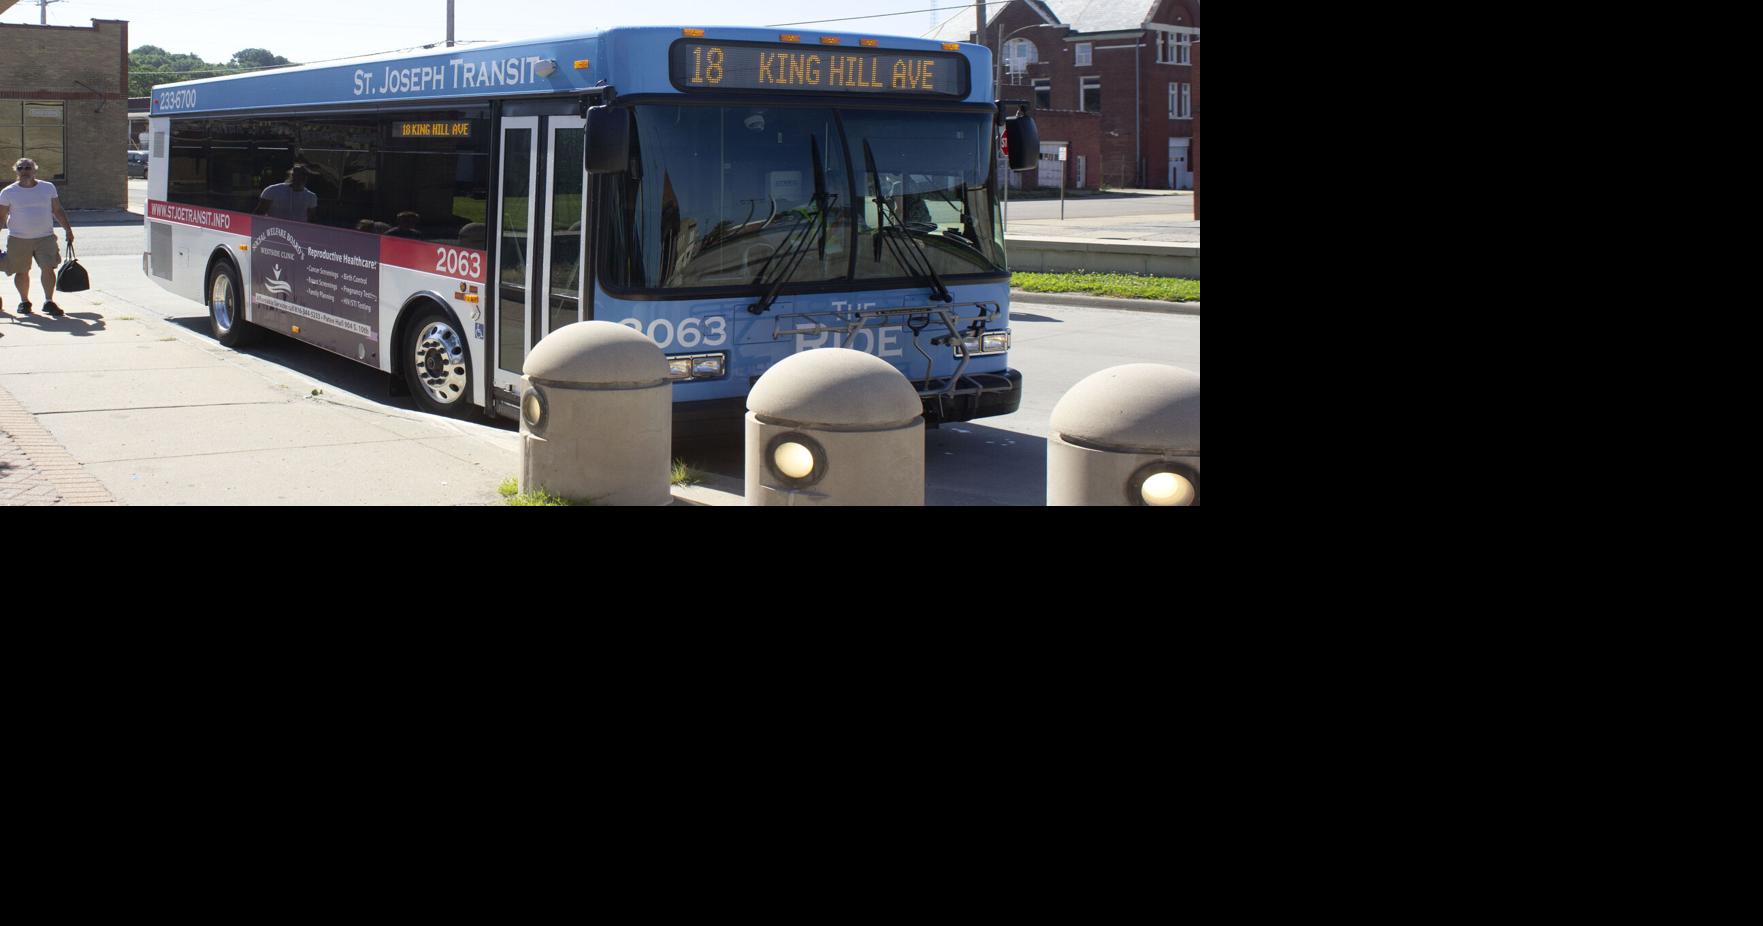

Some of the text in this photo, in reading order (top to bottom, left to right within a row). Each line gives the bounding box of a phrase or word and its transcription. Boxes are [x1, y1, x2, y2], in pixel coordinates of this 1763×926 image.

[379, 65, 445, 94] JOSEPH
[450, 56, 540, 89] TRANSIT
[691, 47, 935, 89] 18 KING HILL AVE
[159, 89, 197, 110] 233-6700
[402, 122, 470, 136] 18 KING HILL AVE
[151, 203, 231, 229] WWW.STJOETRANSIT.INFO
[266, 227, 287, 239] WELFARE
[307, 246, 342, 263] Reproductive
[436, 247, 481, 279] 2063
